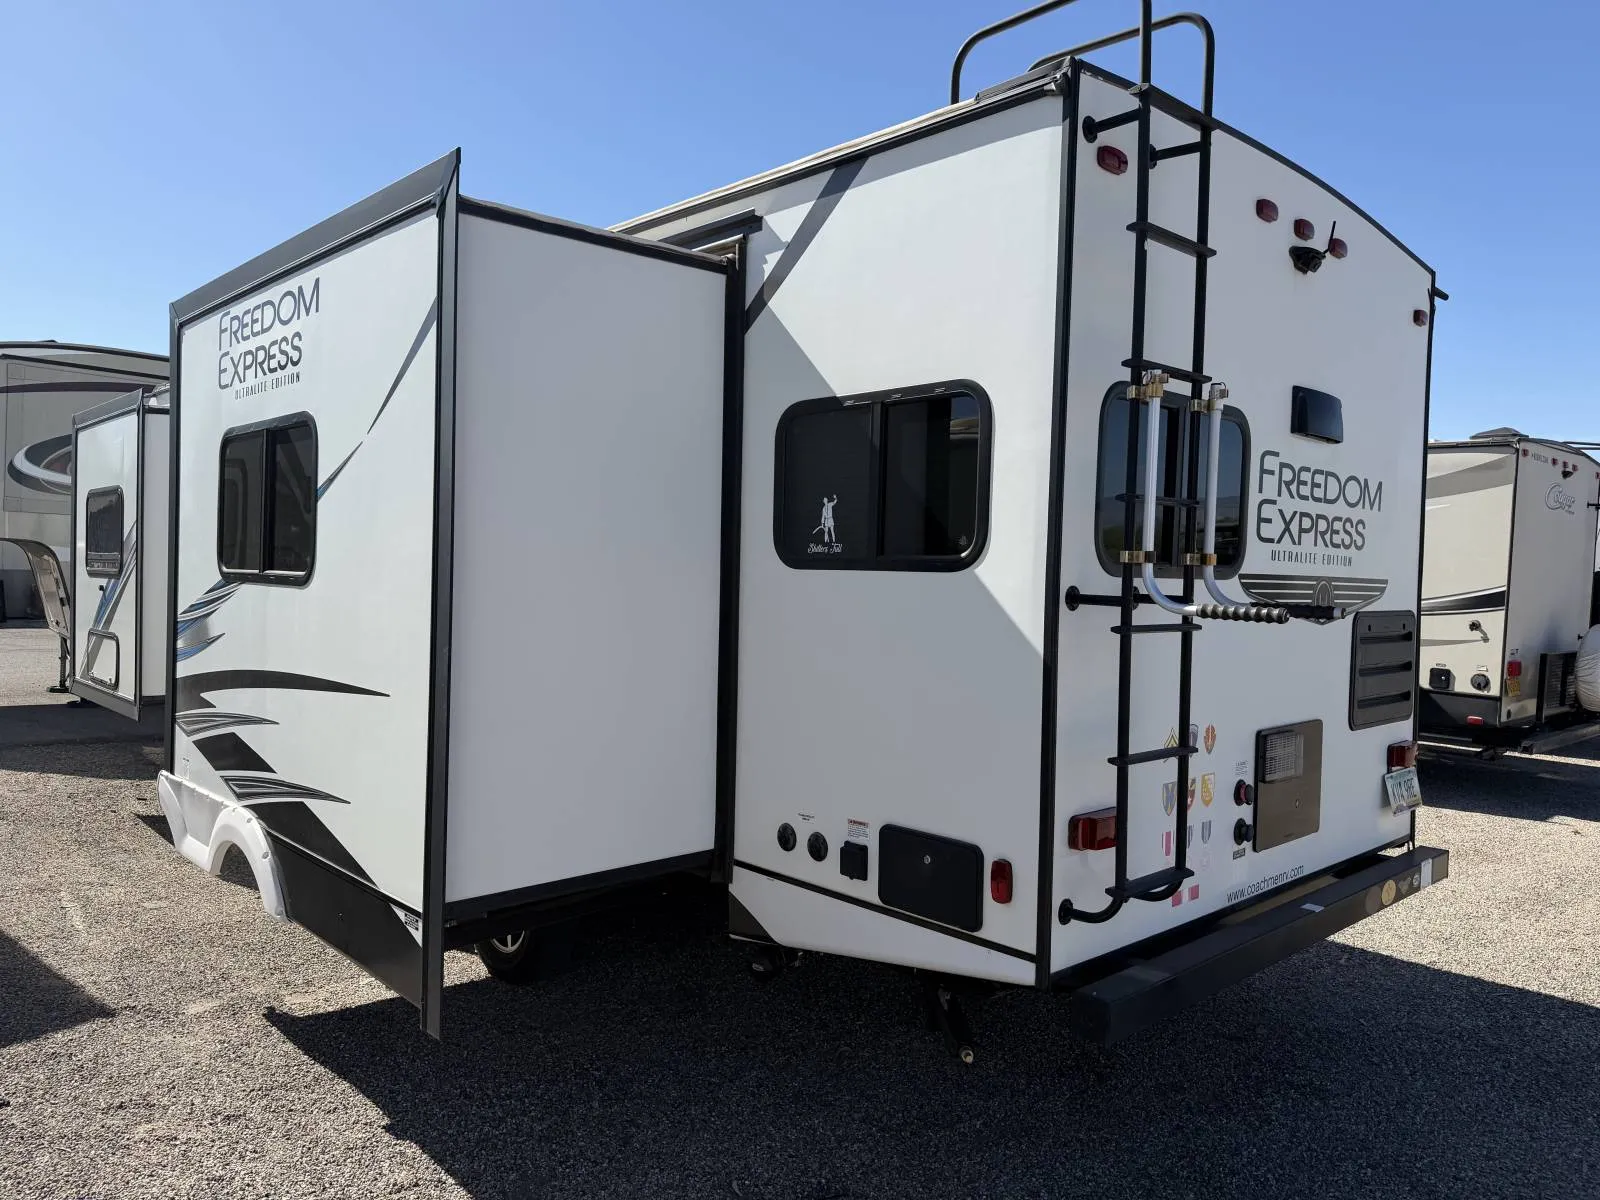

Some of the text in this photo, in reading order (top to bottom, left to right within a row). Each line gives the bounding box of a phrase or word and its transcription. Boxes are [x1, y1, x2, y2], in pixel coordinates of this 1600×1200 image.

[219, 277, 320, 351] FREEDOM
[218, 331, 303, 390] EXPRESS
[234, 371, 301, 400] ULTRALITE EDITION
[1258, 450, 1383, 512] FREEDOM
[1256, 499, 1366, 551] EXPRESS
[1271, 549, 1353, 567] ULTRALITE EDITION
[1226, 864, 1304, 904] www.coachmenrv.com
